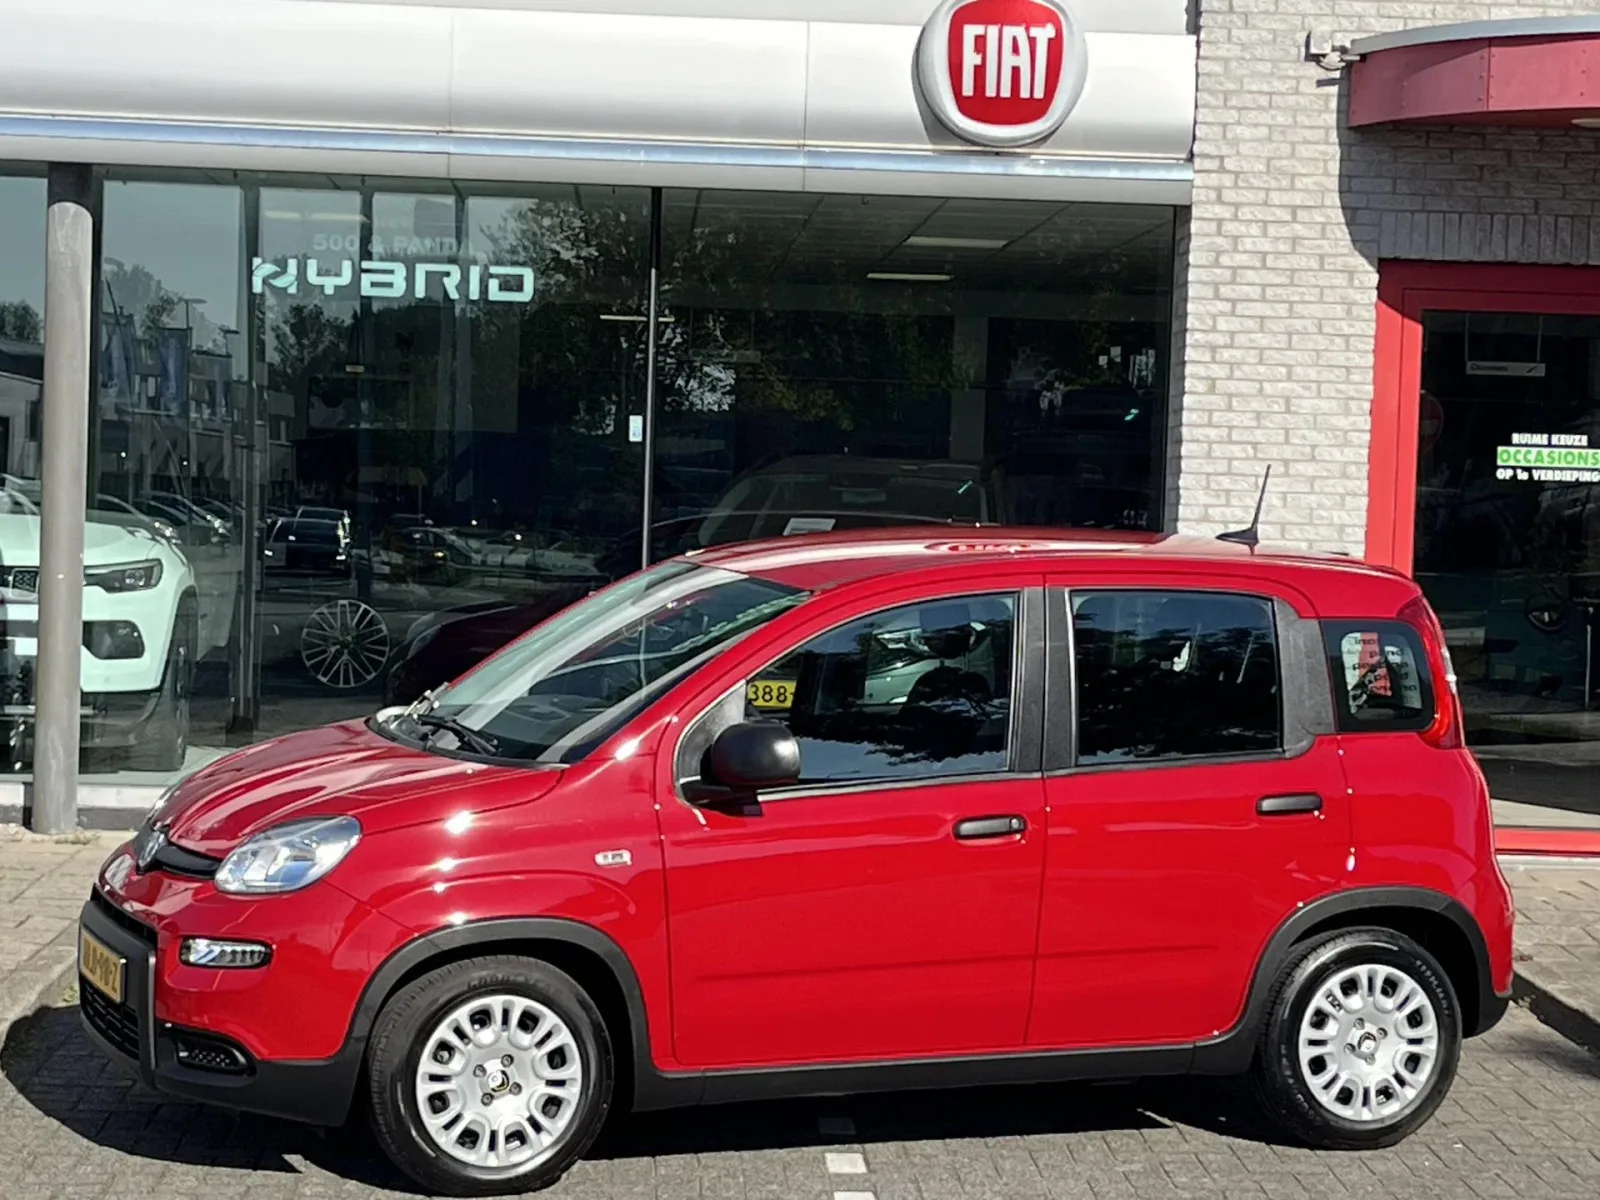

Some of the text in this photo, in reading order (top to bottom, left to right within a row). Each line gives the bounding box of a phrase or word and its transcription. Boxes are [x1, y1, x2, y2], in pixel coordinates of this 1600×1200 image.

[962, 24, 1056, 99] FIAT
[312, 233, 358, 251] 500
[252, 257, 534, 302] HYBRID
[1551, 434, 1588, 446] KEUZE
[1499, 449, 1600, 466] OCCASIONS
[1496, 468, 1514, 480] OP
